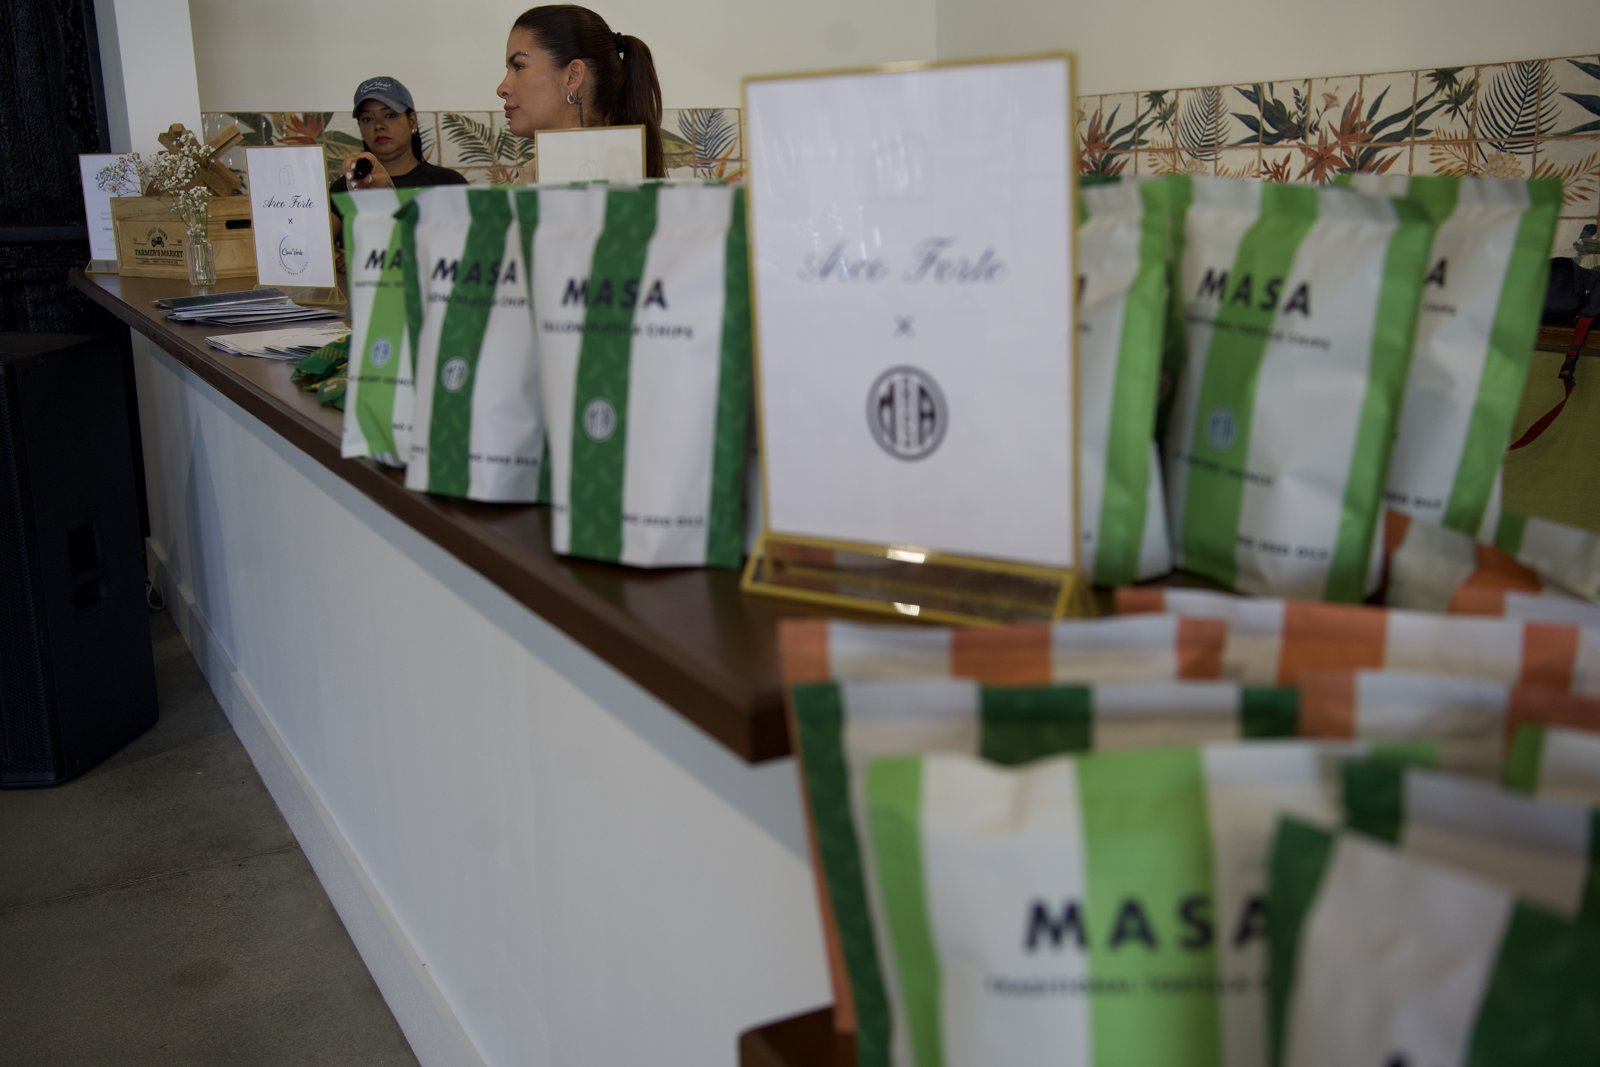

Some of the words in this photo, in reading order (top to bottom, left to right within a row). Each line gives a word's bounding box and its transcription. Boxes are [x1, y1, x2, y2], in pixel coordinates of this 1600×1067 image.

[262, 195, 287, 209] Arco
[288, 194, 315, 209] Forte
[160, 250, 183, 258] MARKET
[906, 235, 1008, 283] Forte
[431, 258, 518, 285] MASA
[561, 279, 667, 310] MASA
[1196, 268, 1311, 319] MASA
[645, 324, 693, 340] CHIPS
